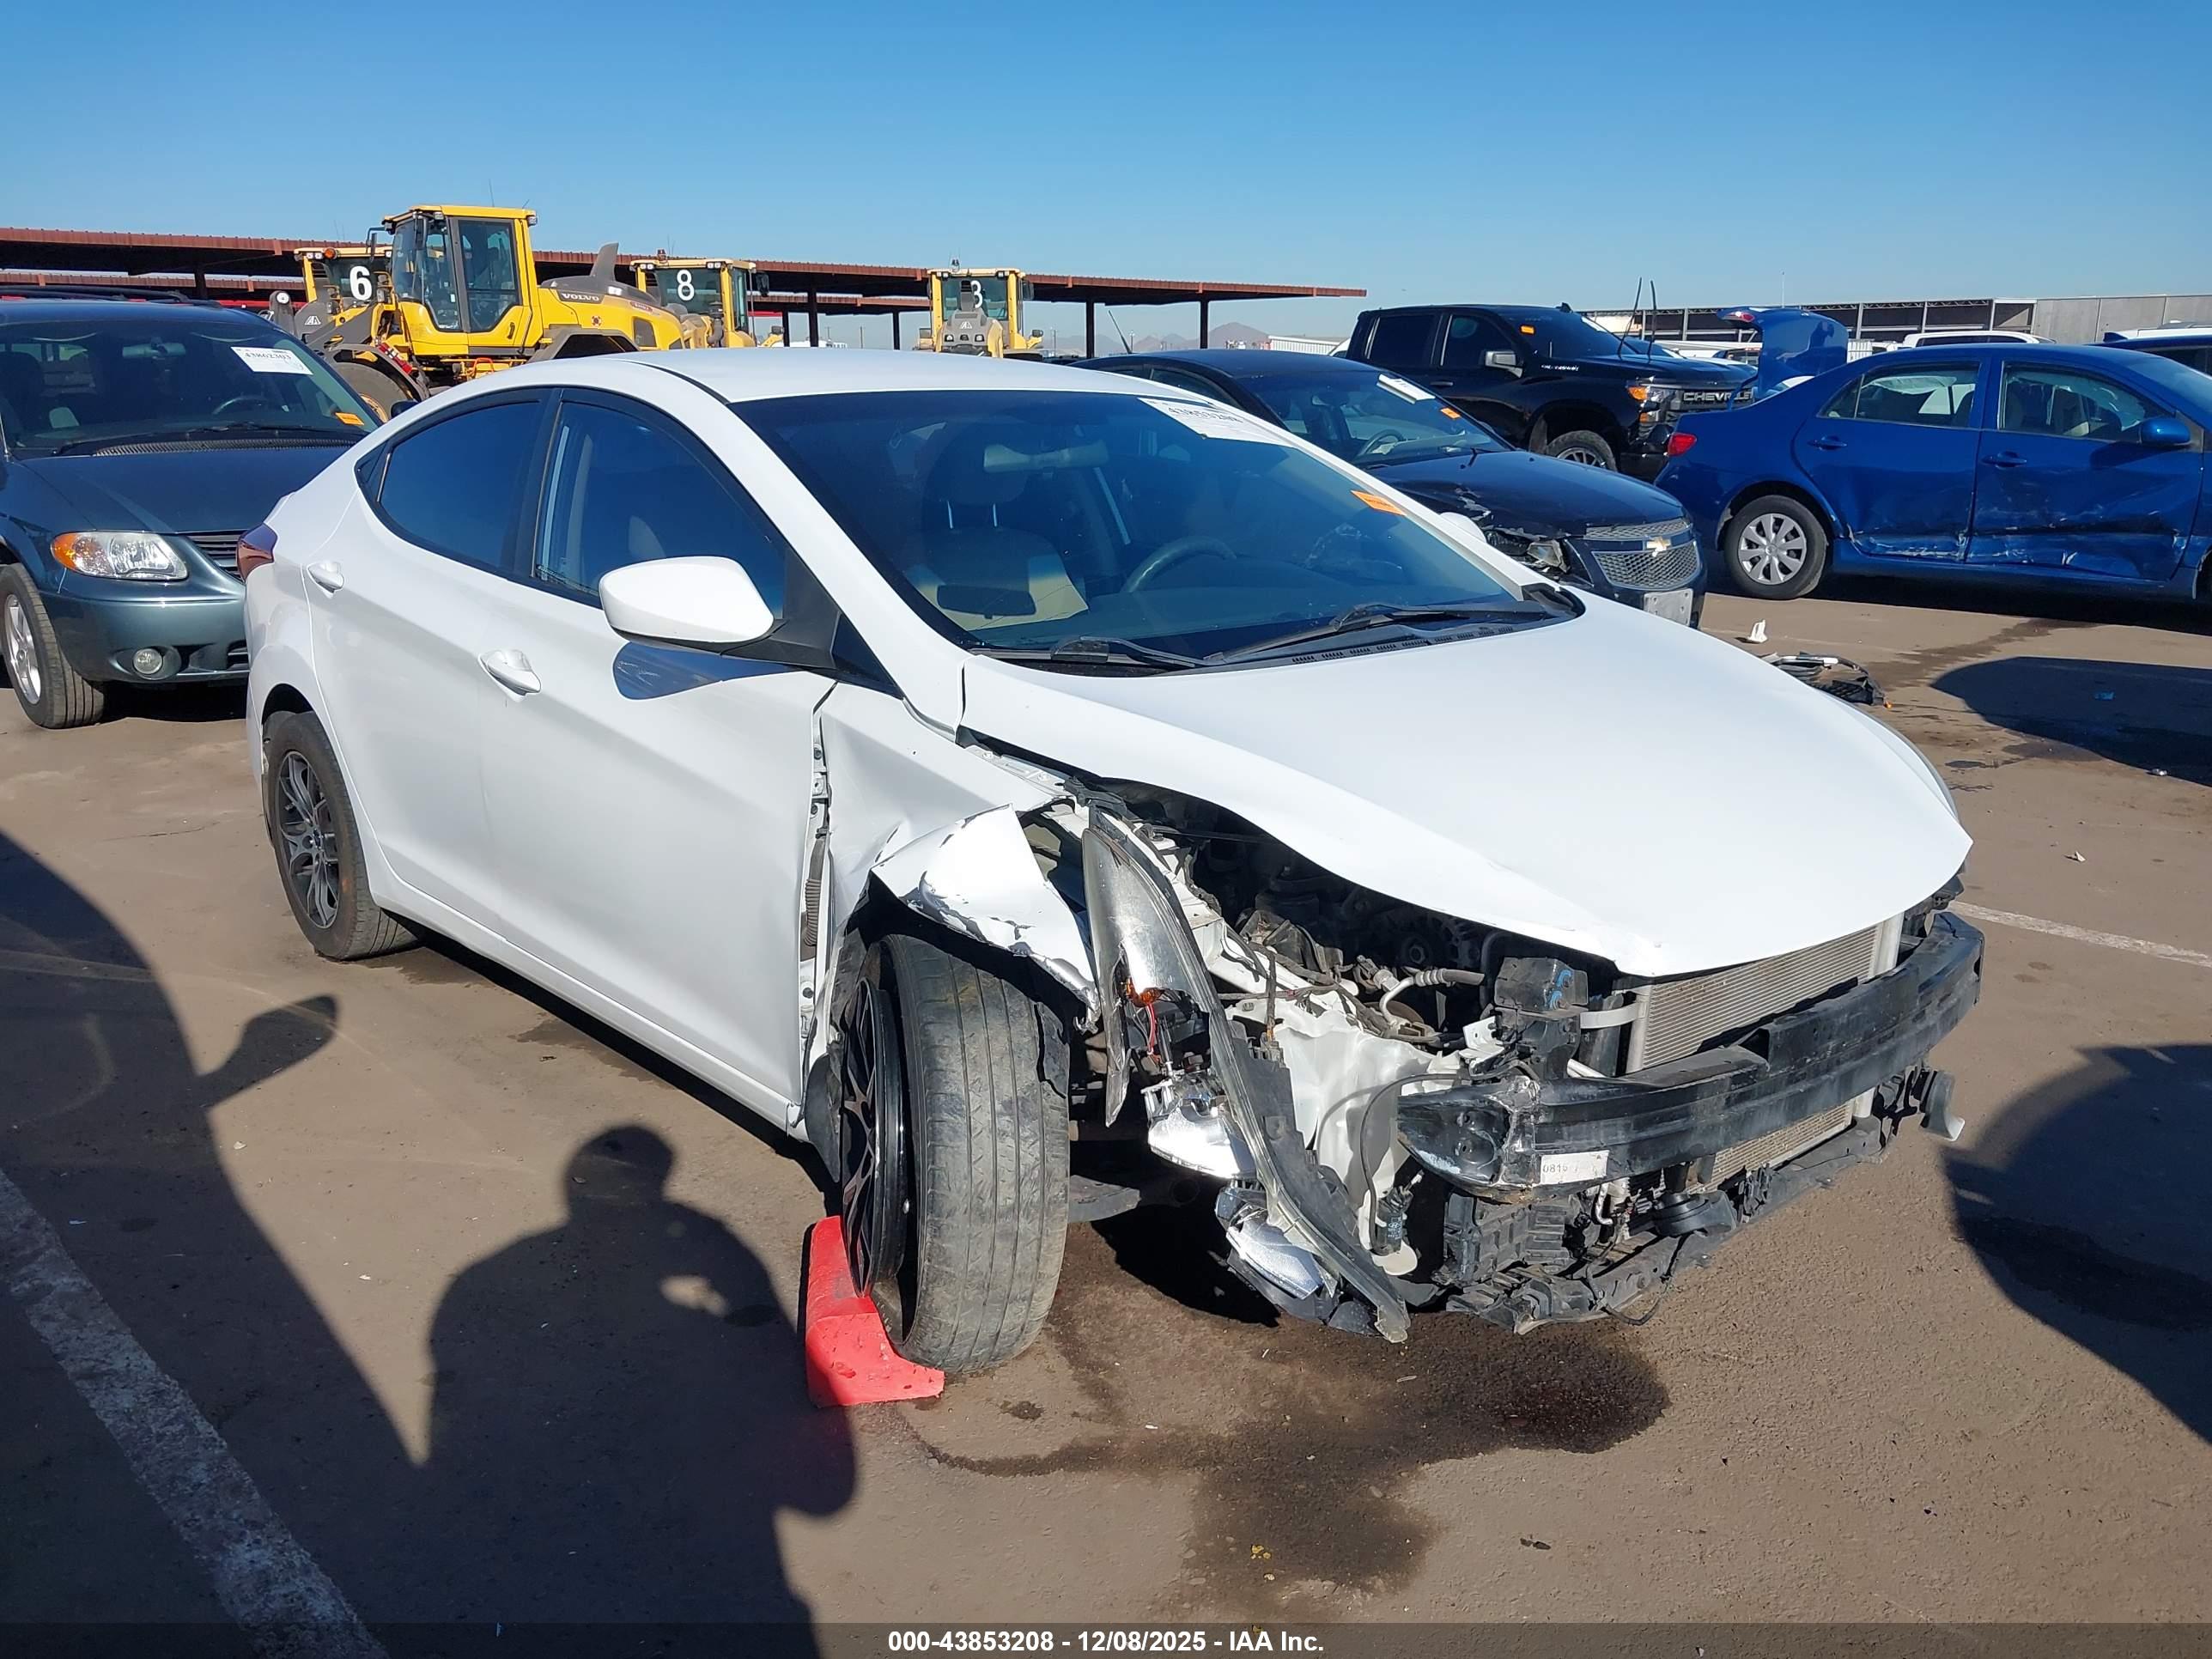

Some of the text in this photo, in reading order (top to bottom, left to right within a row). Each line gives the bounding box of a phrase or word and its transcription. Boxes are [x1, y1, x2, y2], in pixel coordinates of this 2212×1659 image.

[350, 266, 373, 301] 6
[561, 292, 600, 302] VOLVO
[677, 269, 695, 301] 8
